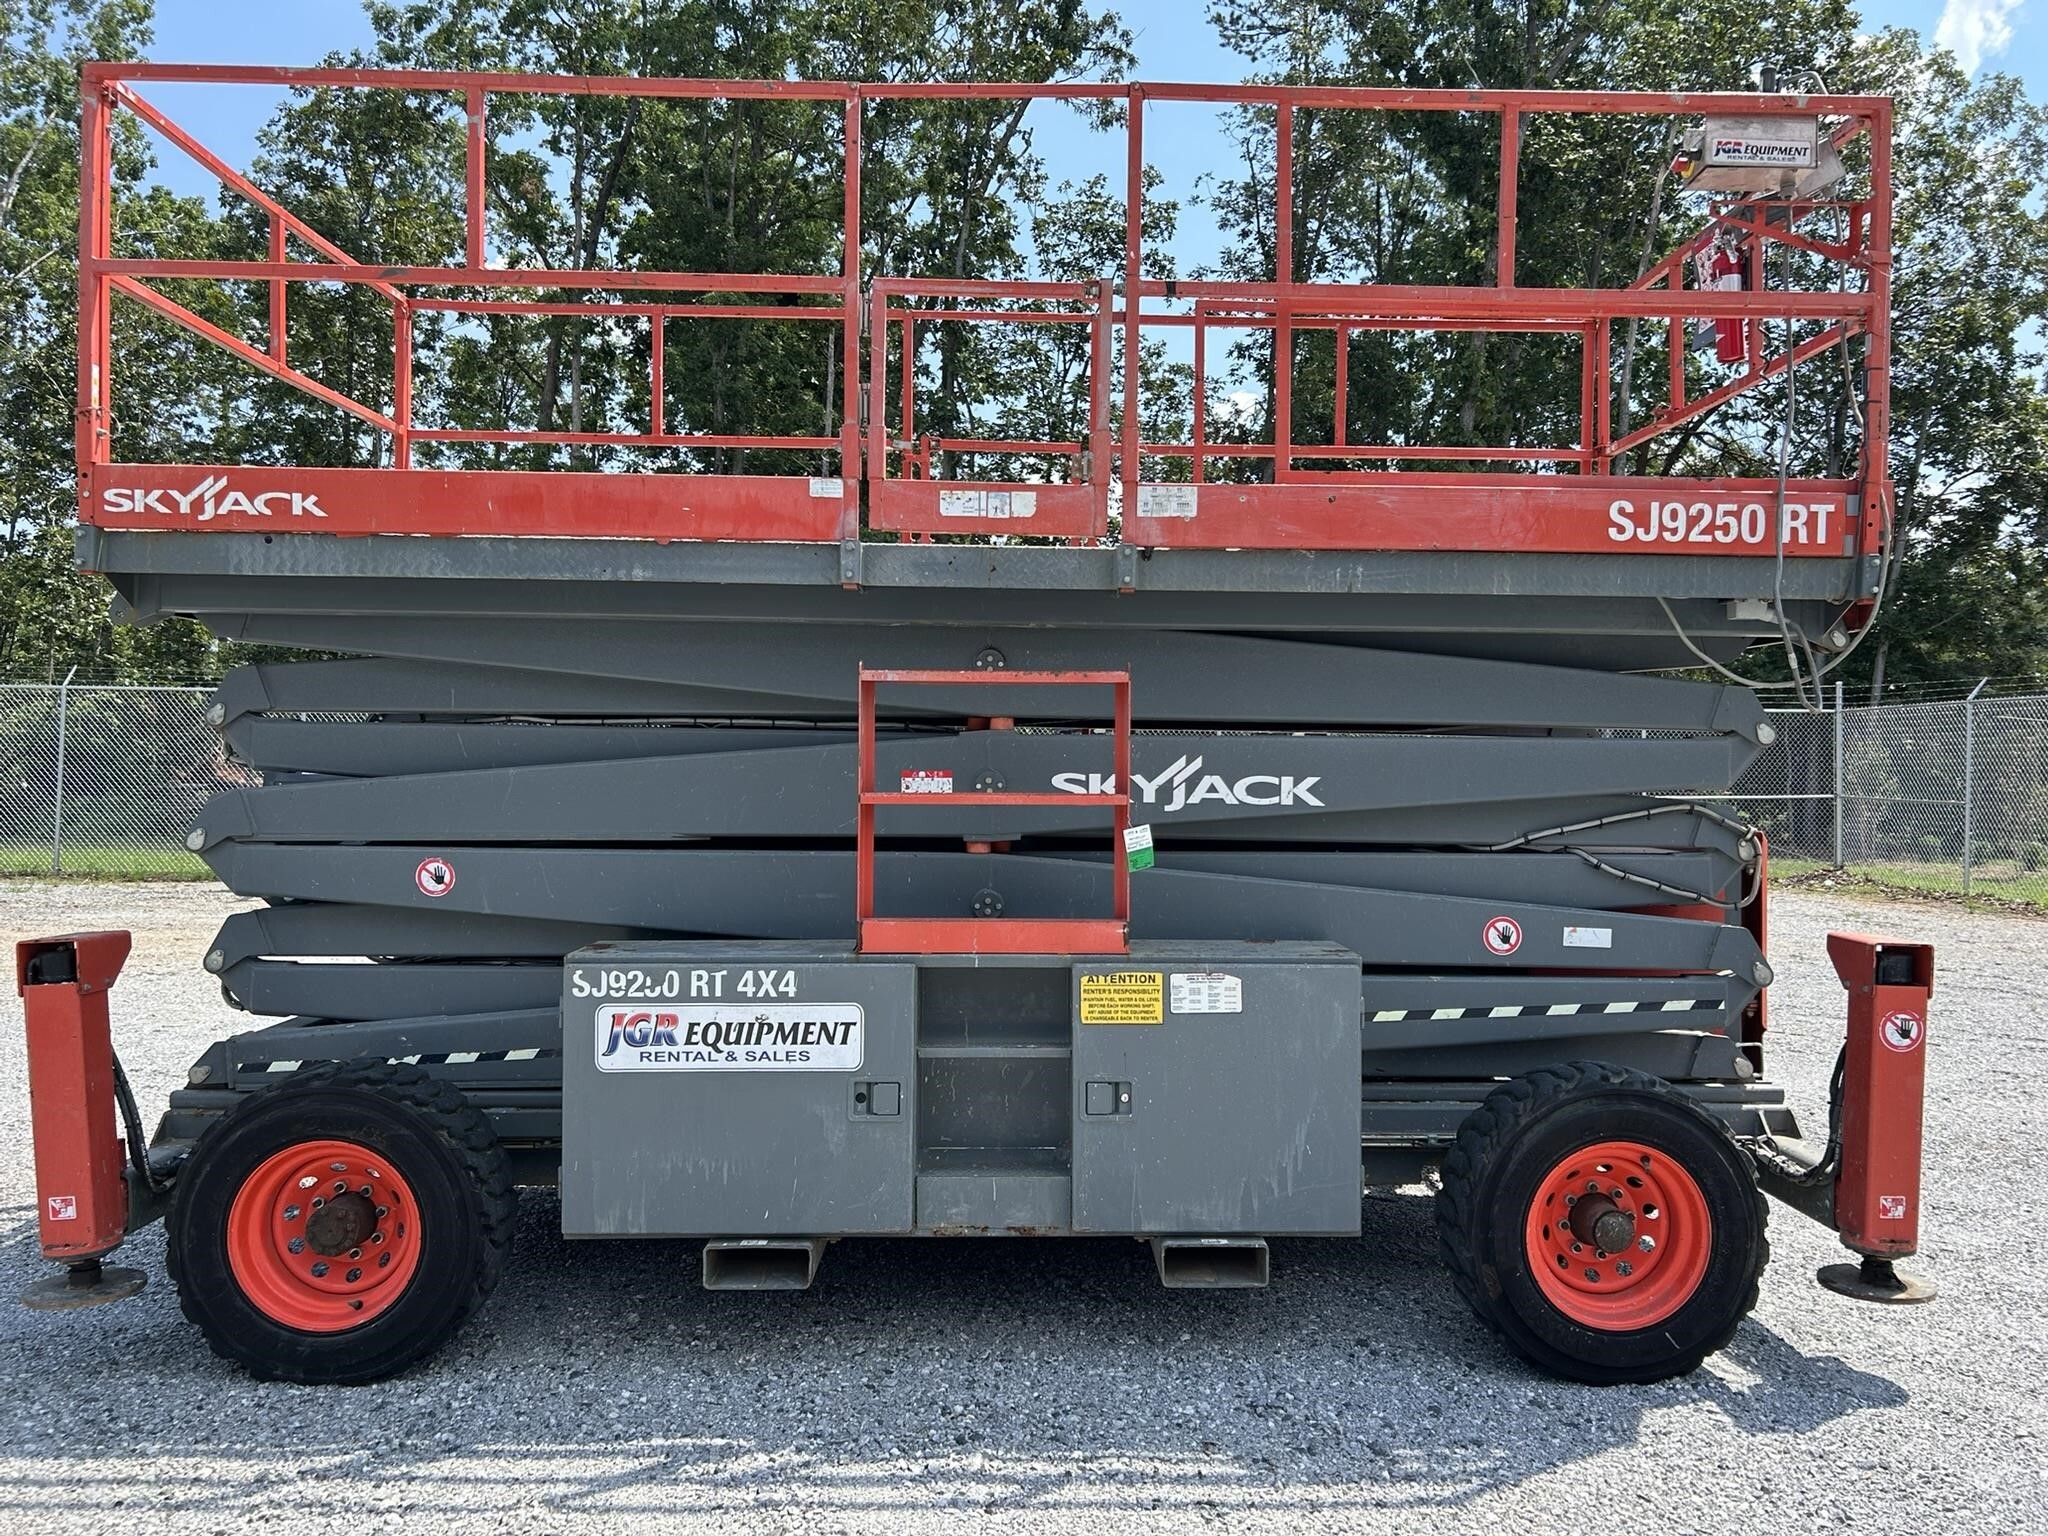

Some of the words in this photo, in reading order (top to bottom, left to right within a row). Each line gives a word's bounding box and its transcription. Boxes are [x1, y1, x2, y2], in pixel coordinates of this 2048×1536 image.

[1714, 141, 1742, 157] JGR
[1744, 145, 1809, 157] EQUIPMENT
[103, 474, 329, 521] SKYJACK
[1608, 500, 1766, 544] SJ9250
[1781, 504, 1836, 544] RT
[1051, 754, 1326, 812] SKYJACK
[690, 970, 727, 998] RT
[737, 970, 797, 998] 4X4
[1087, 974, 1157, 984] ATTENTION
[601, 1012, 680, 1057] JGR
[684, 1021, 857, 1054] EQUIPMENT
[639, 1051, 718, 1062] RENTAL
[726, 1051, 738, 1062] &
[752, 1051, 811, 1062] SALES
